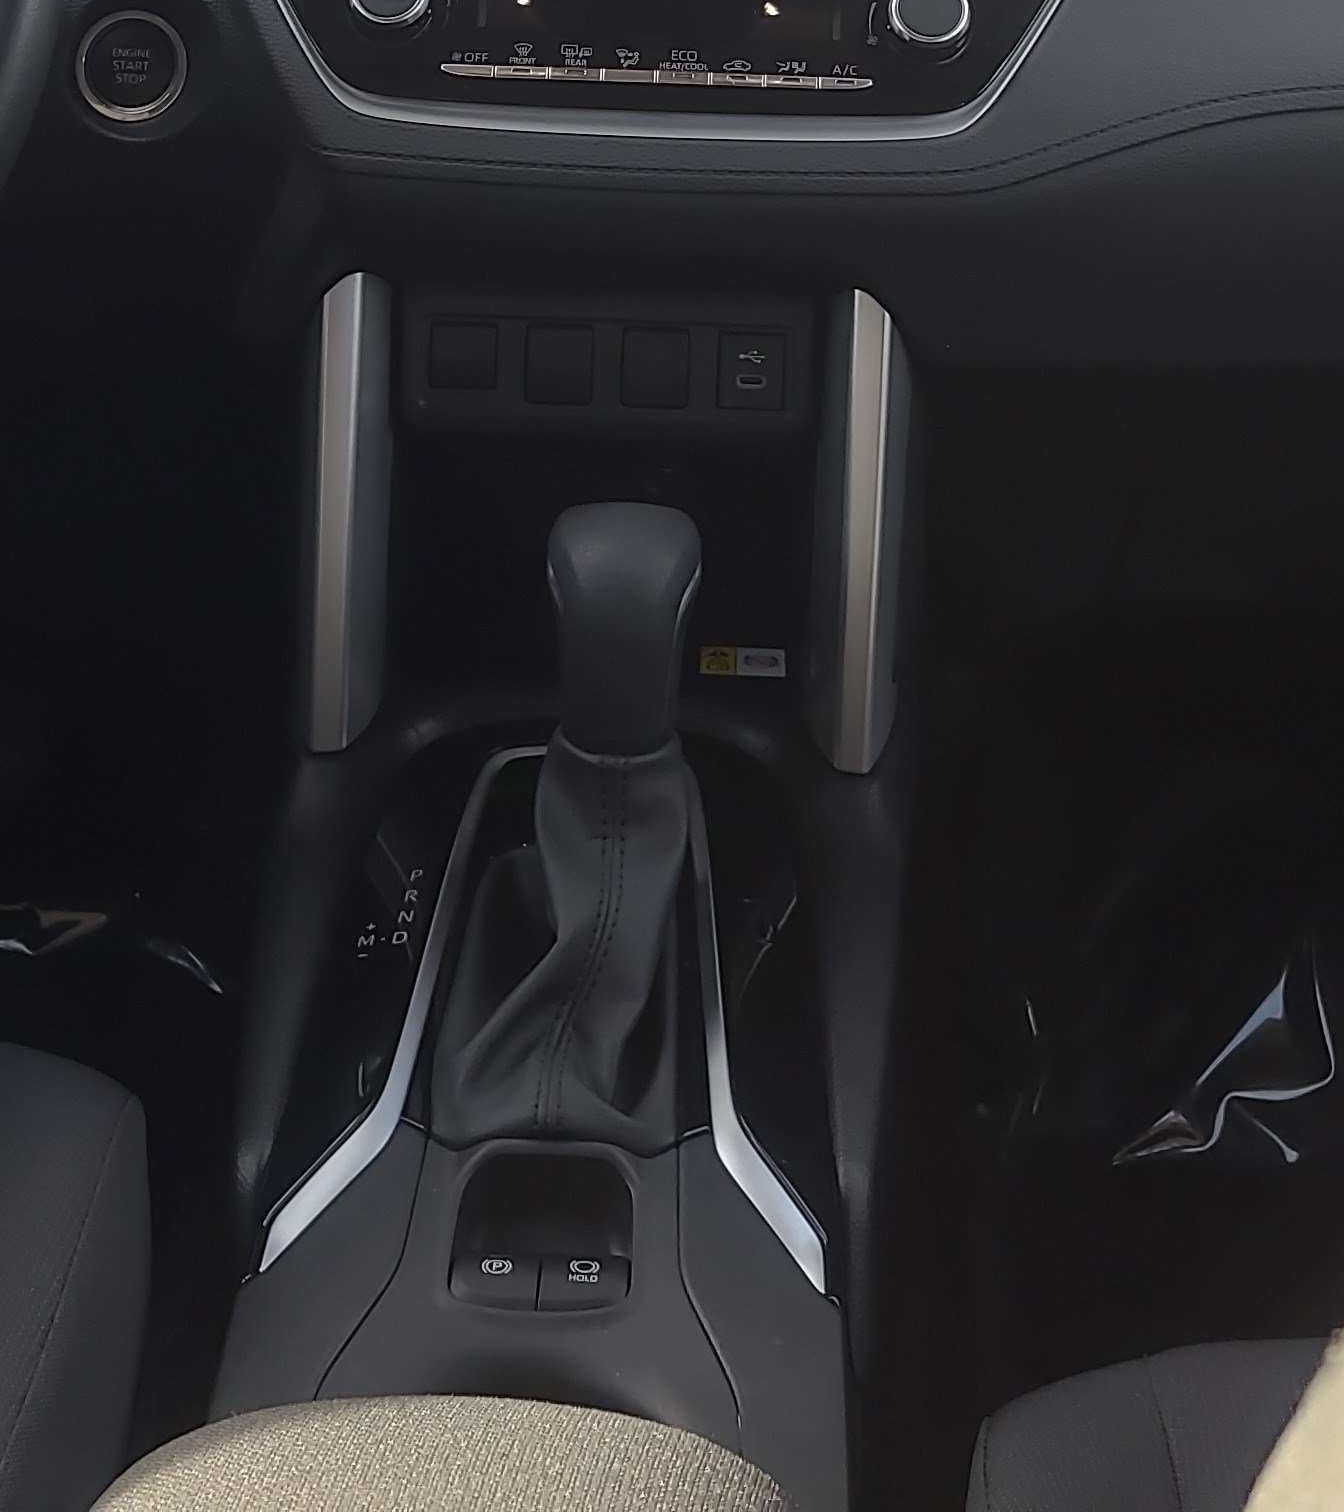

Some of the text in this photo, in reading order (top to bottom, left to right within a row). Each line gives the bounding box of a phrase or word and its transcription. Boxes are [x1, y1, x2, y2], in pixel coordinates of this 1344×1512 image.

[112, 48, 152, 59] ENGINE
[464, 52, 489, 63] OFF
[671, 49, 698, 61] ECO
[113, 59, 150, 71] START
[509, 57, 536, 65] FRONT
[564, 58, 587, 67] REAR
[659, 61, 709, 71] HEAT/COOL
[832, 64, 858, 76] A/C
[116, 72, 147, 84] STOP
[410, 868, 424, 882] P
[404, 889, 418, 902] R
[397, 909, 415, 924] N
[357, 931, 408, 948] M D
[568, 1273, 598, 1283] HOLD
